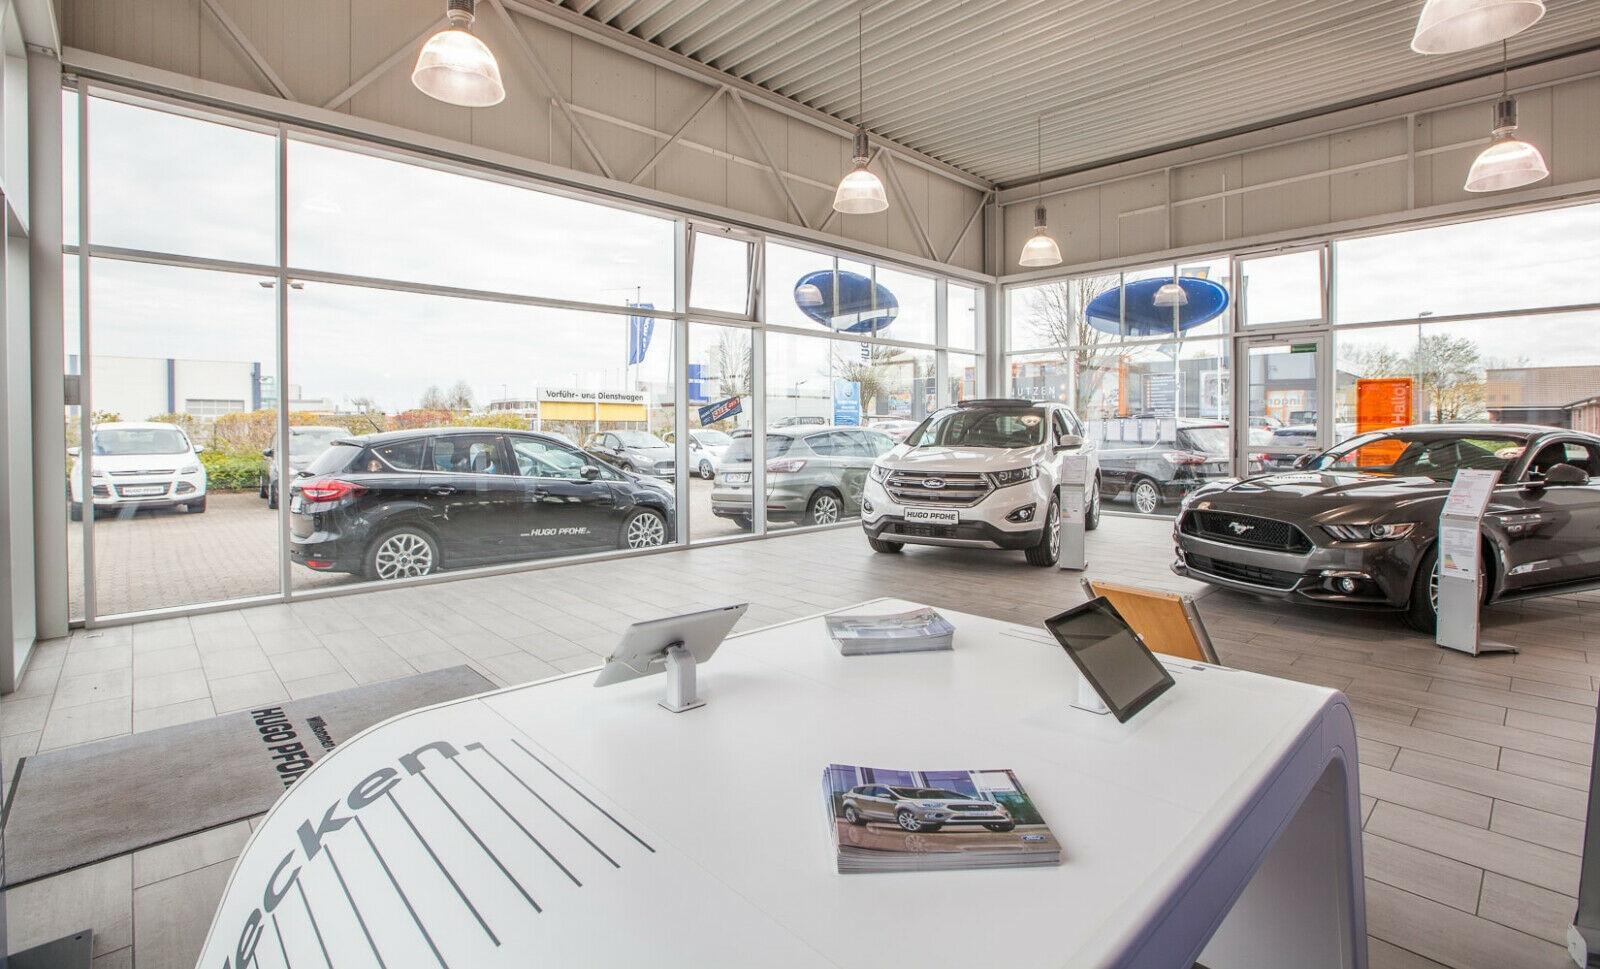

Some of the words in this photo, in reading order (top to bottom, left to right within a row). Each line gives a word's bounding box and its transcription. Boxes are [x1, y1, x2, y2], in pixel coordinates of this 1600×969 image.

[546, 390, 578, 398] Vorführ-
[598, 392, 643, 402] Dienstwagen
[907, 511, 928, 519] HUGO
[930, 513, 956, 521] PFOHE
[531, 528, 556, 536] HUGO
[558, 527, 587, 535] PFOHE
[251, 707, 297, 743] HUGO
[268, 741, 314, 790] PFOH
[222, 741, 482, 969] ecken.
